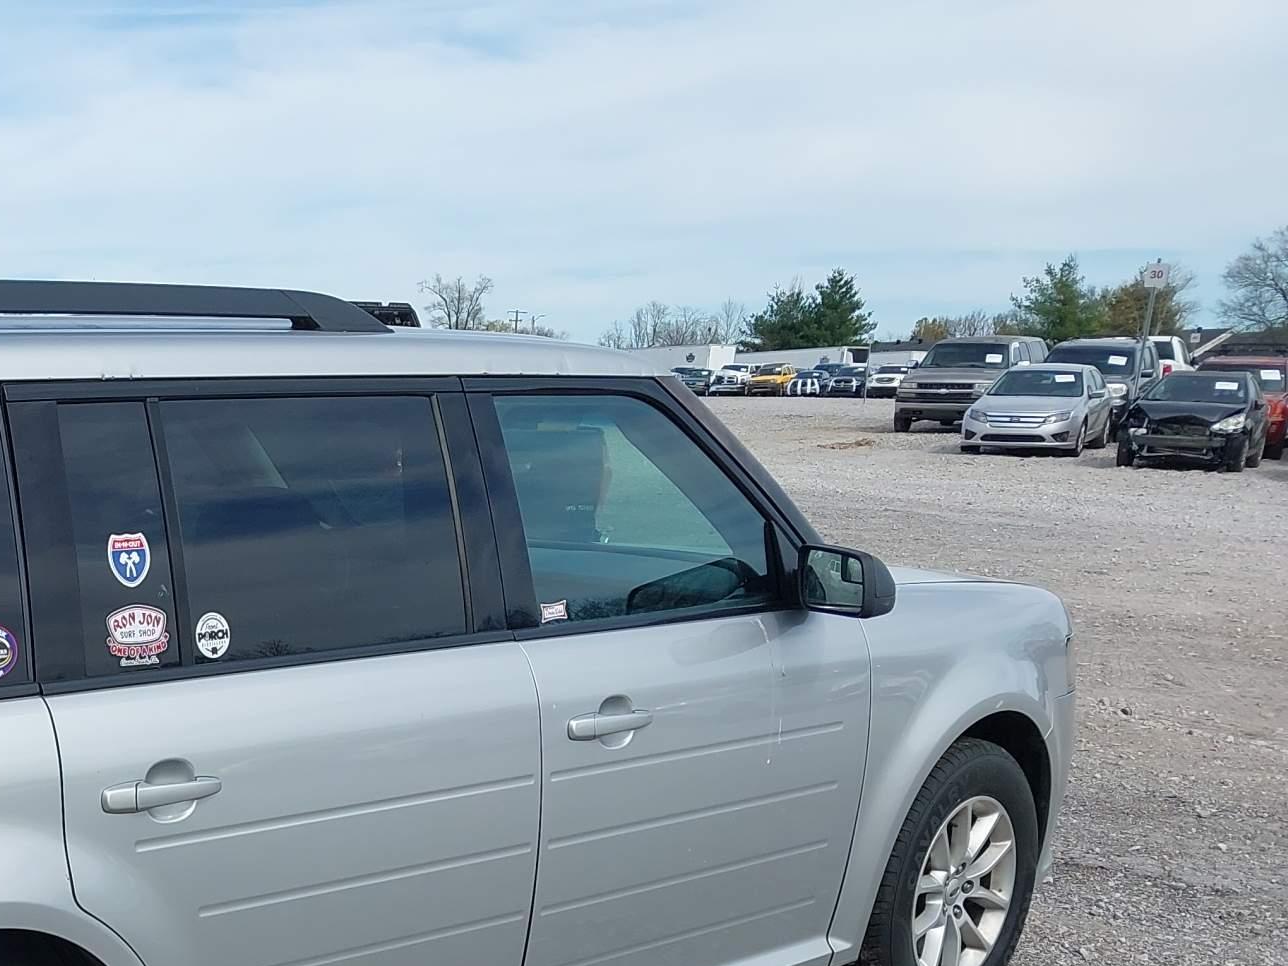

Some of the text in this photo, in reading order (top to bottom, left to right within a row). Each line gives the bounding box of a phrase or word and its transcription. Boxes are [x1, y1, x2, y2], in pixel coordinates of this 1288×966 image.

[1150, 270, 1163, 279] 30
[113, 612, 162, 632] RON JON
[120, 629, 156, 639] SURF SHOP
[198, 628, 229, 643] PORCH
[112, 644, 127, 656] ONE
[129, 646, 141, 657] OF
[149, 641, 167, 655] KIND
